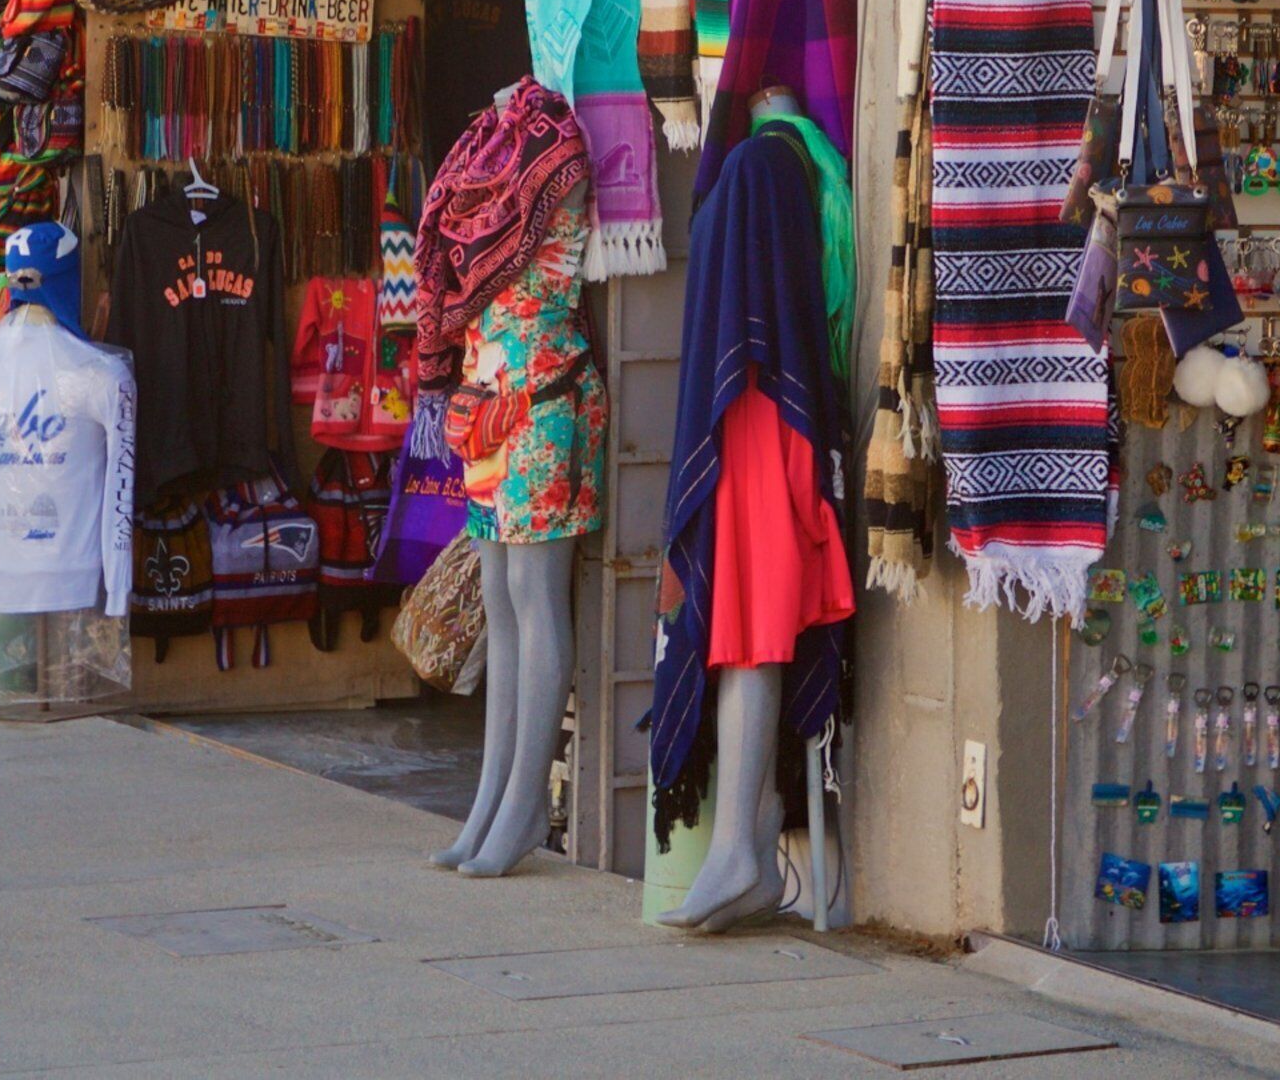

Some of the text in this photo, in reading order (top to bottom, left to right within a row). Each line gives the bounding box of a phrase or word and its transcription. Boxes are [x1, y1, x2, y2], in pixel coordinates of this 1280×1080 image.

[207, 269, 254, 299] LUCAS
[22, 443, 68, 466] Lucas
[253, 570, 297, 584] PATRIOTS
[147, 595, 195, 612] SAINTS
